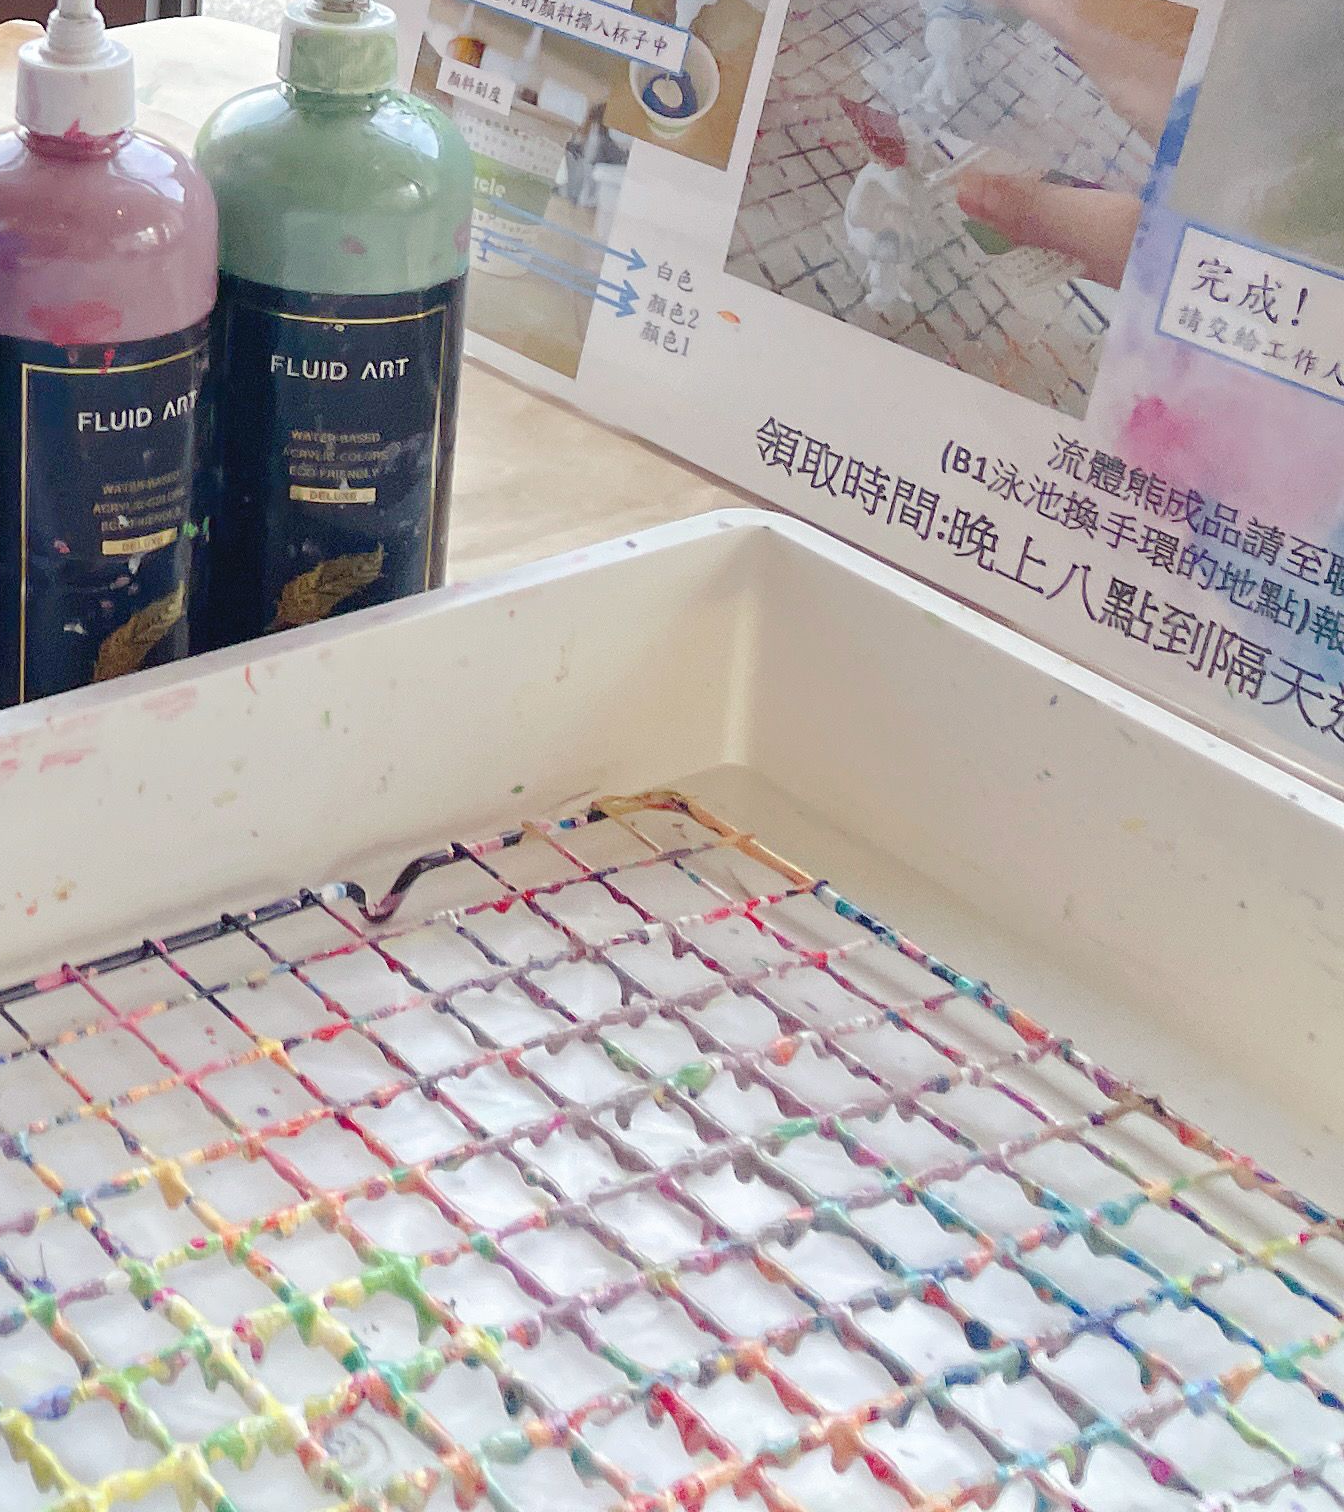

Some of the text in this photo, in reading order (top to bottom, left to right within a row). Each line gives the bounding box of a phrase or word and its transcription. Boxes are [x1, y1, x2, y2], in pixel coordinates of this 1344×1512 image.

[657, 261, 694, 293] 白色
[647, 293, 700, 330] 顏色2
[270, 354, 410, 381] FLUID ART
[77, 390, 198, 433] FLUID ART
